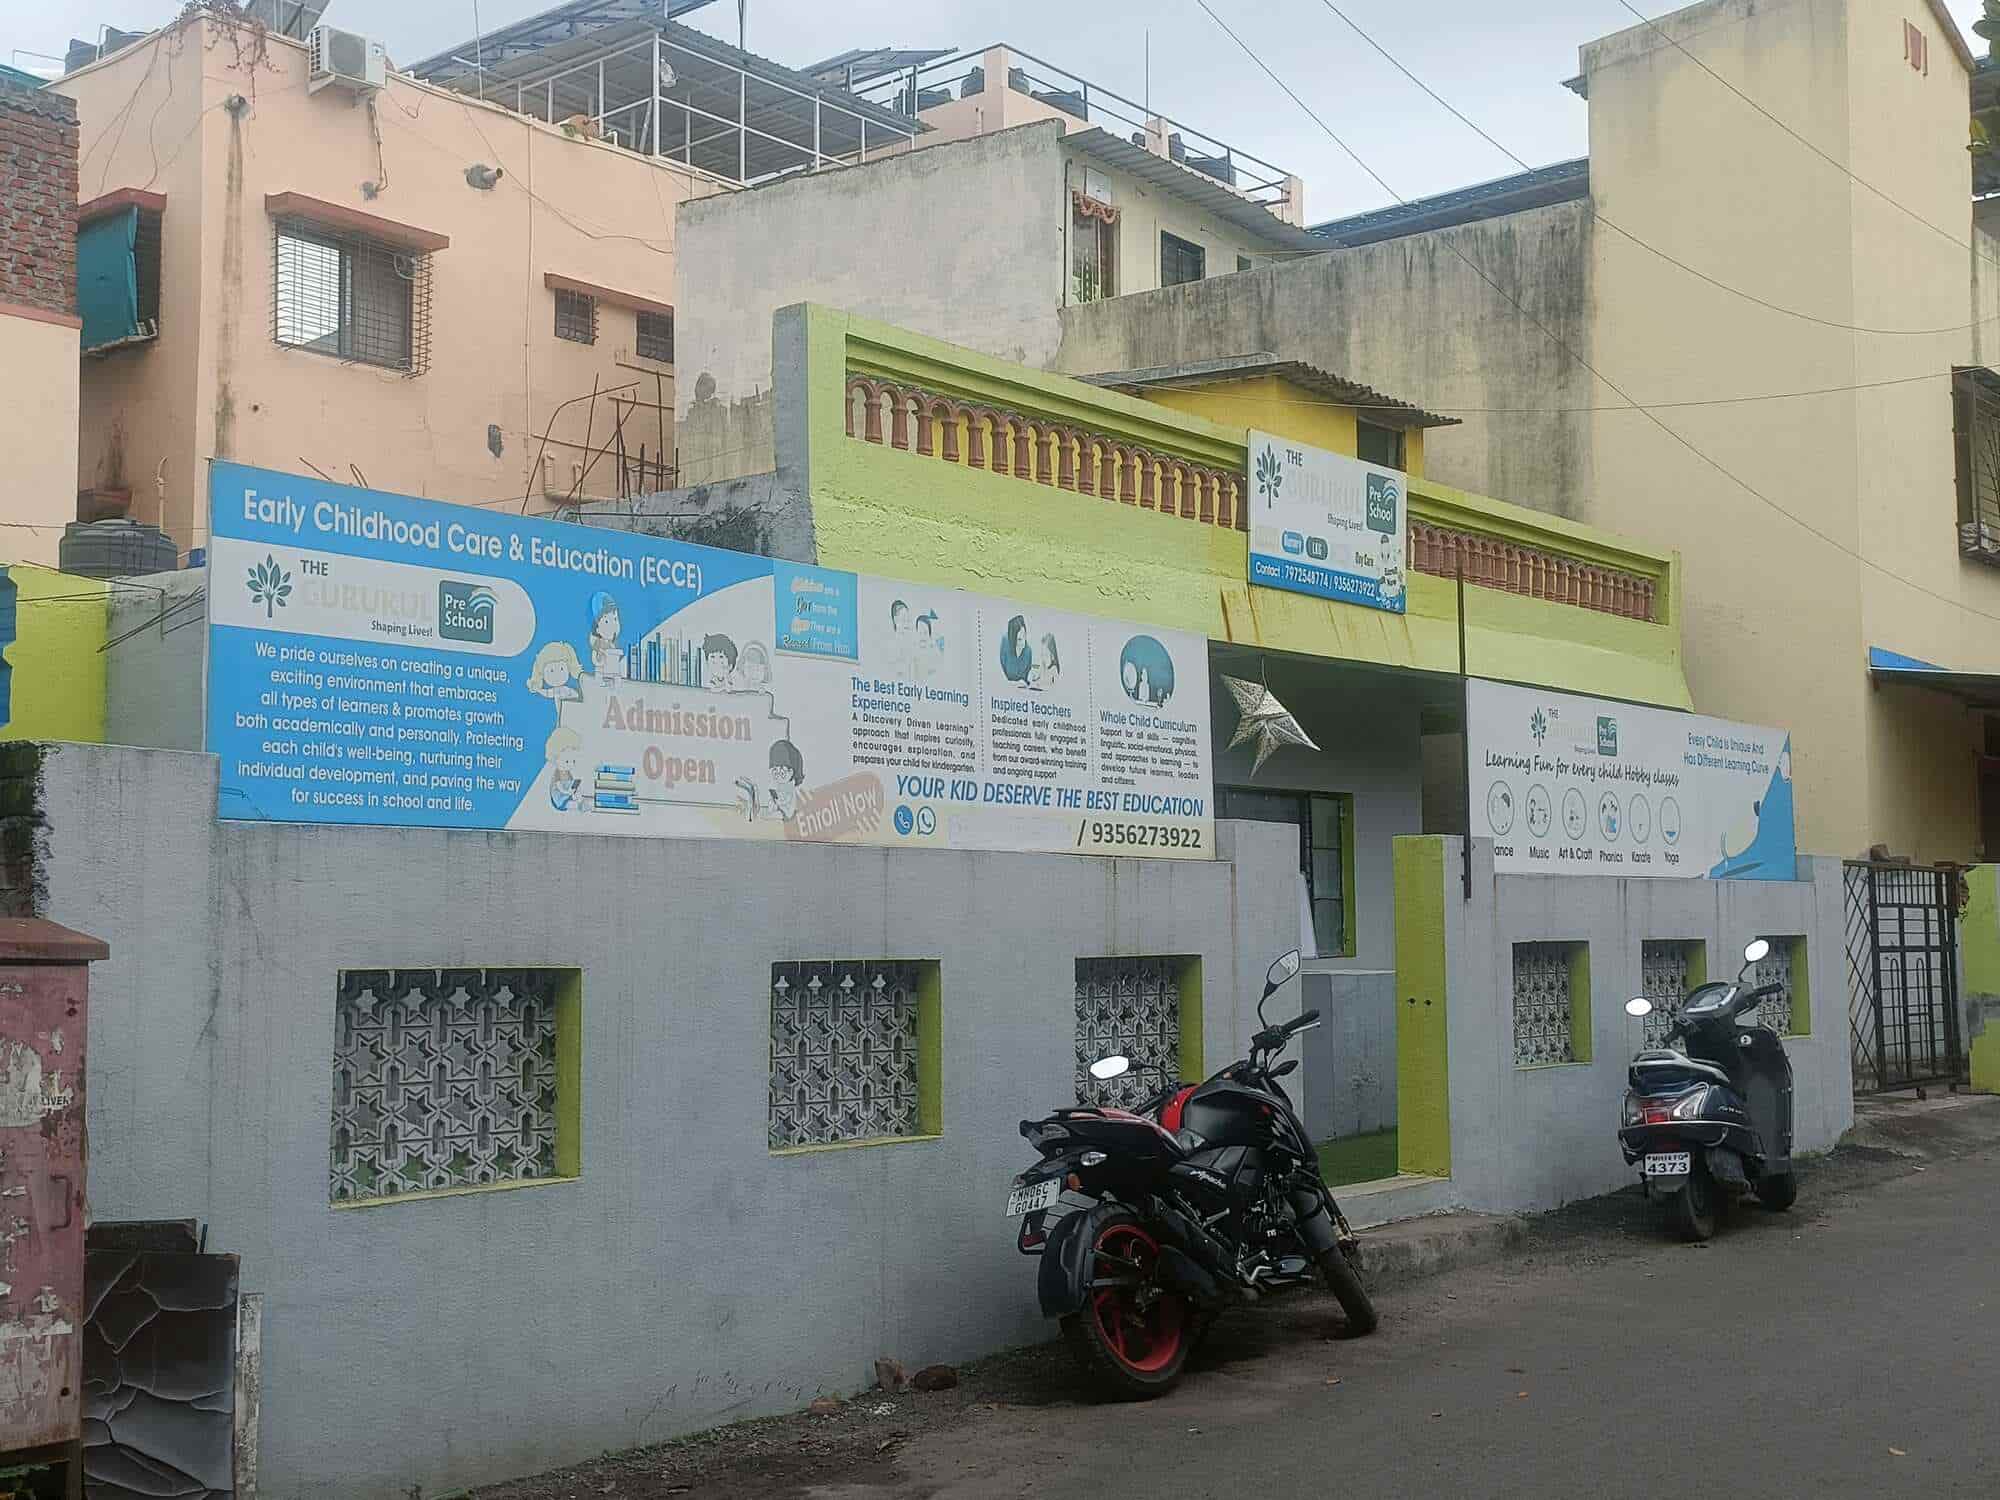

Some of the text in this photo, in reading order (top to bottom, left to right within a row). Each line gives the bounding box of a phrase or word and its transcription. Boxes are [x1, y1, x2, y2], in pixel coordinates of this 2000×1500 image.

[1286, 449, 1302, 467] THE
[1368, 486, 1381, 501] Pre
[1368, 503, 1392, 522] School
[244, 488, 702, 596] Early Childhood Care & Education (ECCE)
[300, 559, 328, 576] THE
[1256, 562, 1280, 577] Contact
[444, 594, 466, 610] Pre
[371, 620, 433, 638] Shaping Lives!
[444, 611, 487, 631] School
[255, 641, 510, 684] We pride ourselves on creating a unique,
[270, 670, 497, 702] exciting environment that embraces
[851, 676, 970, 708] The Best Early Learning
[261, 691, 504, 726] all types of learners & promotes growth
[851, 694, 911, 714] Experience
[991, 696, 1072, 718] Inspired Teachers
[602, 694, 752, 742] Admission
[852, 712, 858, 722] A
[863, 712, 902, 726] Discovery
[906, 717, 932, 730] Driven
[992, 714, 1087, 733] Dedicated early childhood
[1100, 710, 1198, 733] Whole Child Curriculum
[236, 712, 524, 752] both academically and personally. Protecting
[852, 728, 975, 748] approach that inspires curiosity,
[1080, 736, 1087, 744] in
[852, 740, 902, 754] encourages
[960, 750, 976, 760] and
[1688, 732, 1705, 750] Every
[1706, 735, 1723, 750] Child
[1752, 742, 1764, 755] And
[262, 740, 502, 770] each child's well-being, nurturing their
[852, 754, 885, 766] prepares
[886, 758, 902, 768] your
[902, 757, 920, 768] child
[921, 758, 932, 769] for
[1684, 752, 1768, 775] Has Different Learning Curve
[238, 760, 522, 794] individual development, and paving the way
[642, 744, 716, 790] Open
[993, 766, 1006, 775] and
[1007, 768, 1033, 778] ongoing
[1485, 748, 1680, 788] Learning Fun for every child Hobby classes
[291, 787, 476, 811] for success in school and life.
[896, 774, 1204, 817] YOUR KID DESERVE THE BEST EDUCATION
[794, 796, 840, 838] Enroll
[1077, 818, 1201, 849] / 9356273922
[1528, 846, 1550, 860] Music
[1558, 847, 1593, 860] Art & Craft
[1600, 850, 1624, 863] Phonics
[1632, 851, 1652, 864] Karate
[1664, 851, 1680, 866] Yoga
[1648, 1162, 1688, 1173] 4373
